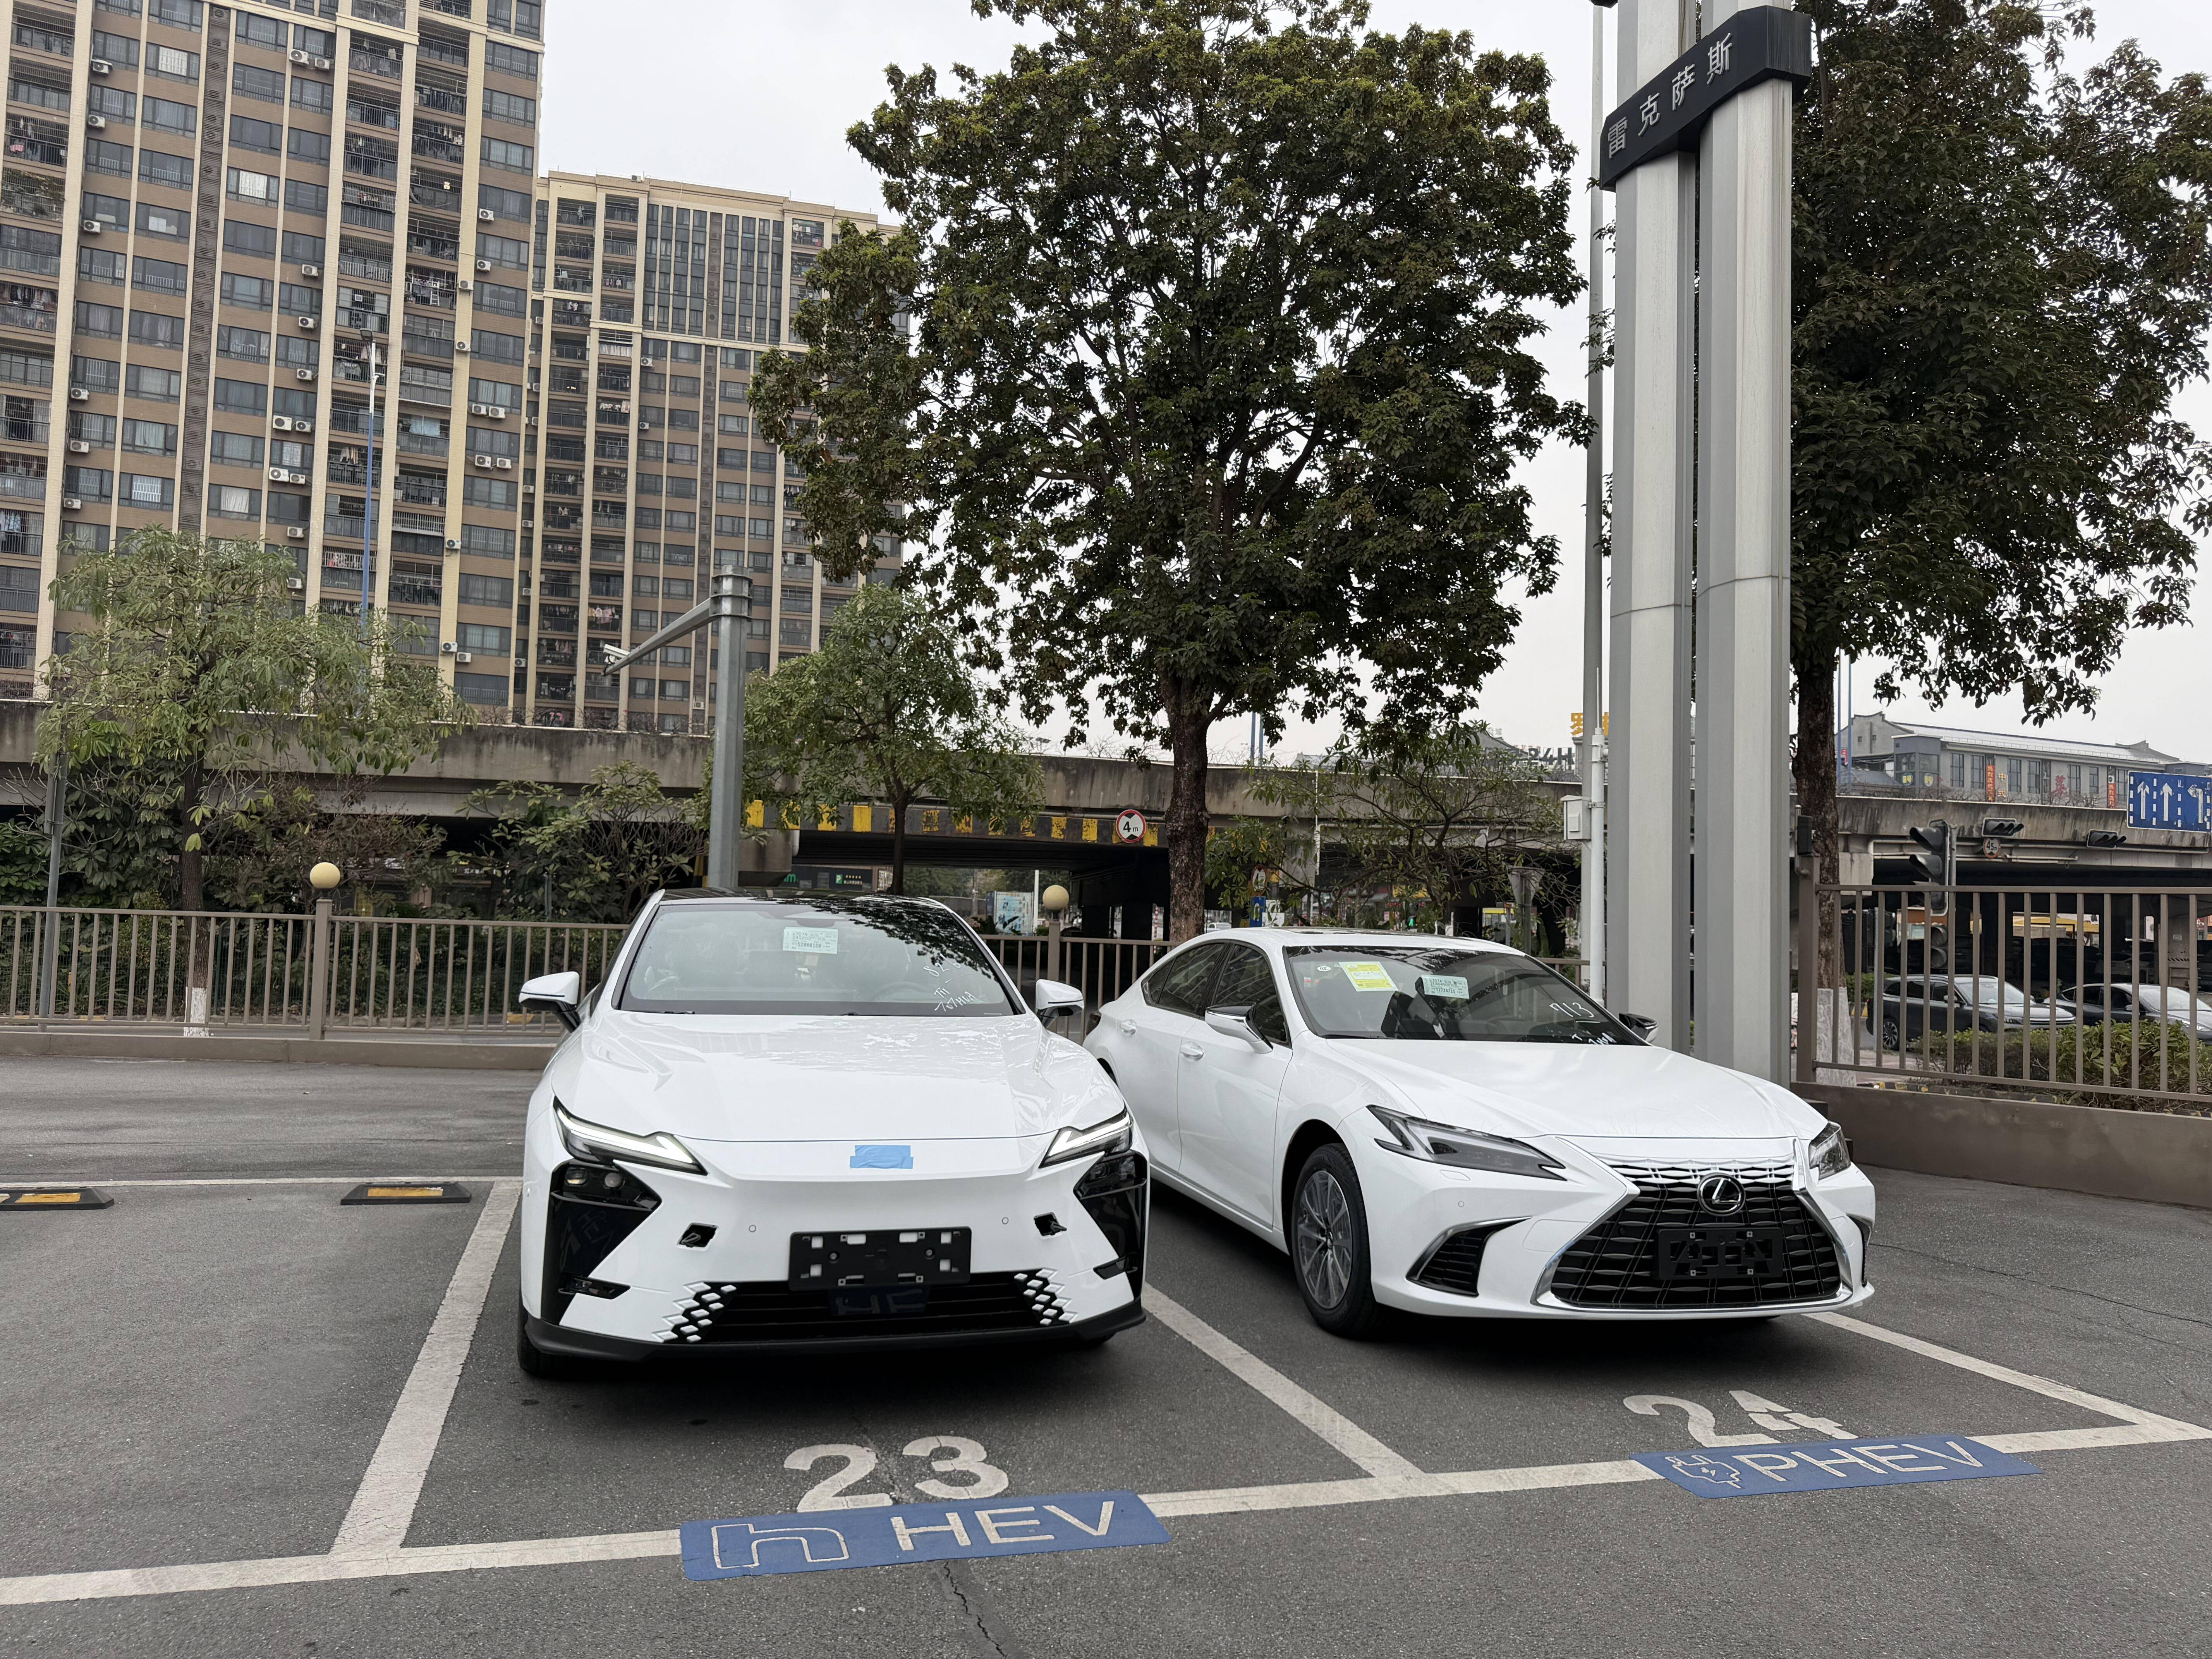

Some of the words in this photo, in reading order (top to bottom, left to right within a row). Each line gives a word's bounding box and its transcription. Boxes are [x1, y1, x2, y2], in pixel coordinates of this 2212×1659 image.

[1607, 33, 1733, 159] 雷克萨斯
[1623, 1389, 1860, 1449] 24
[783, 1435, 1010, 1513] 23
[1732, 1440, 1984, 1482] PHEV
[890, 1500, 1115, 1551] HEV
